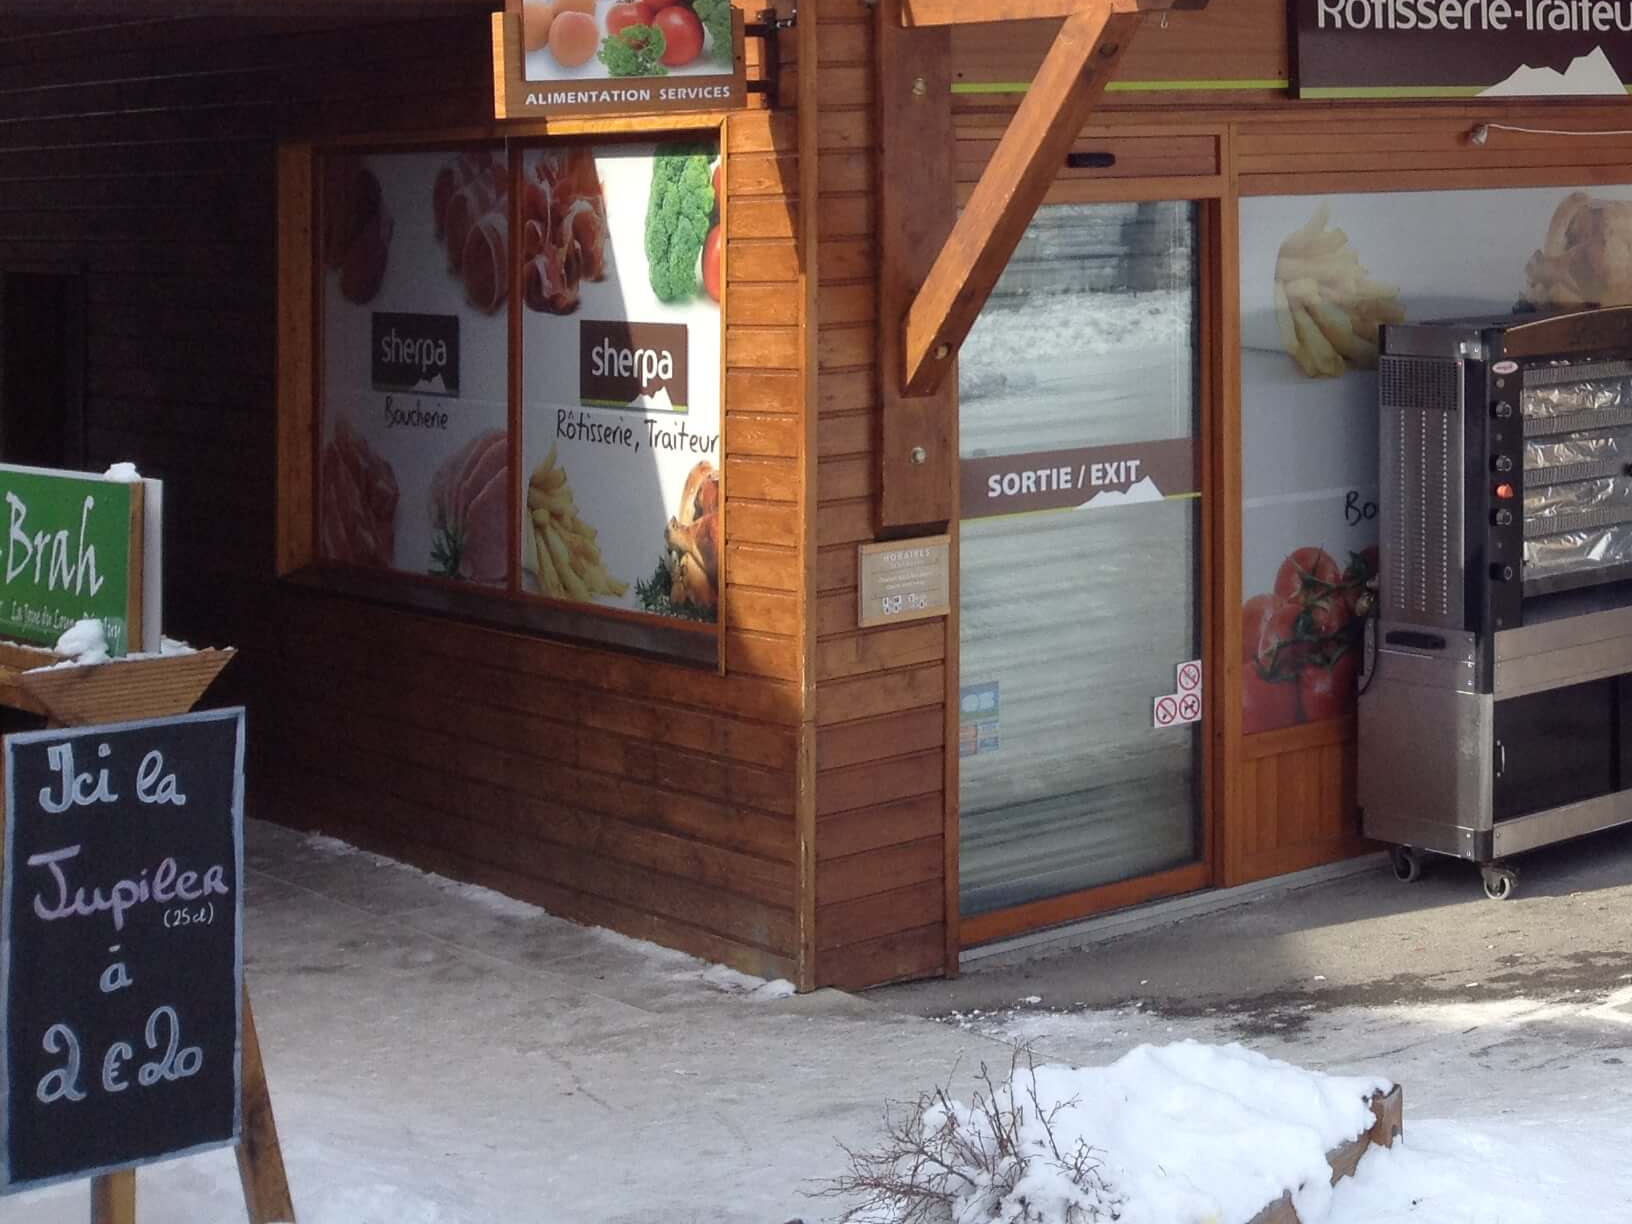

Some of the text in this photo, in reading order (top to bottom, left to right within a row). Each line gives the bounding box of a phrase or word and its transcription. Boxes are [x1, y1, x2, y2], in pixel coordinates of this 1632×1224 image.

[525, 85, 731, 106] ALIMENTATION SERVICES
[381, 327, 447, 372] sherpa
[591, 337, 673, 388] sherpa
[384, 395, 448, 431] Boucherie
[556, 408, 720, 454] Rôtisserie, Traiteur
[986, 459, 1141, 498] SORTIE / EXIT
[5, 490, 105, 598] Brah
[136, 749, 187, 806] la
